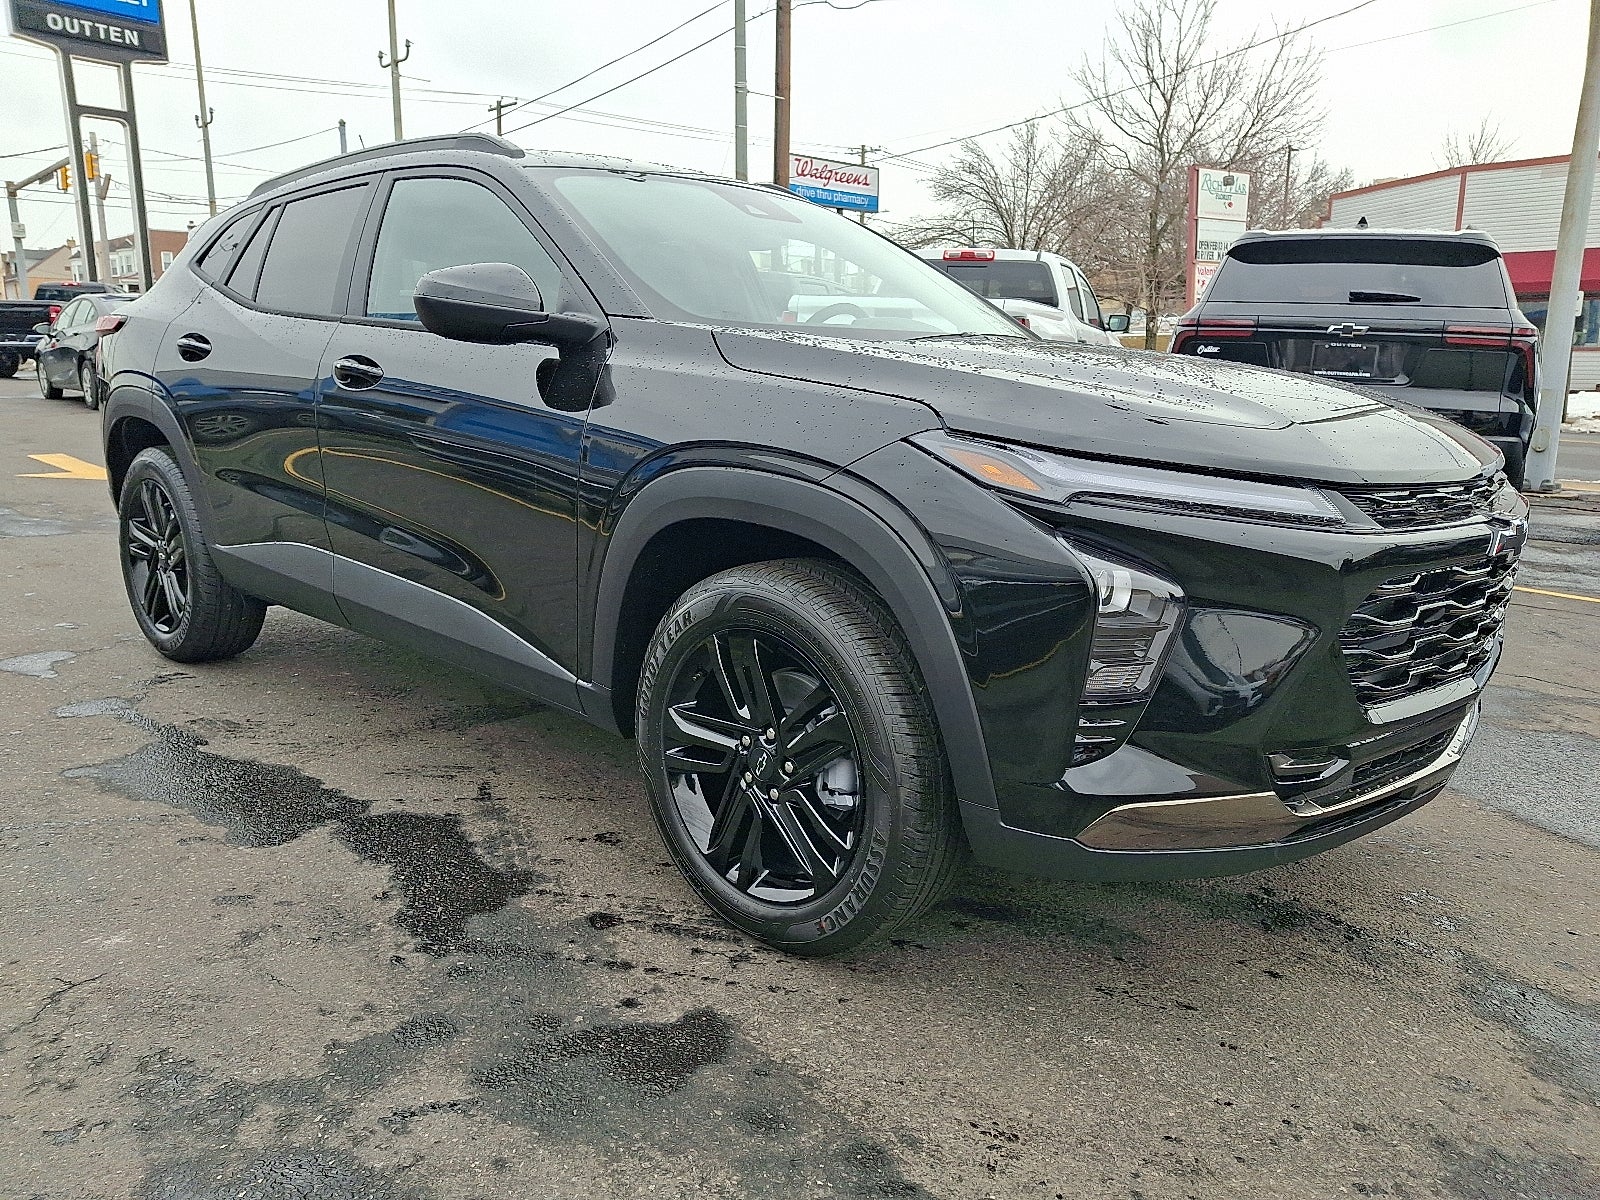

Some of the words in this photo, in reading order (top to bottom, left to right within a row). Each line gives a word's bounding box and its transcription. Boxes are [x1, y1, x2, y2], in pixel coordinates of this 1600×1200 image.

[47, 13, 140, 46] OUTTEN
[794, 158, 870, 187] Walgreens
[796, 186, 816, 198] drive
[816, 189, 832, 200] thru
[833, 192, 869, 207] pharmacy
[814, 827, 888, 936] ASSURANCE
